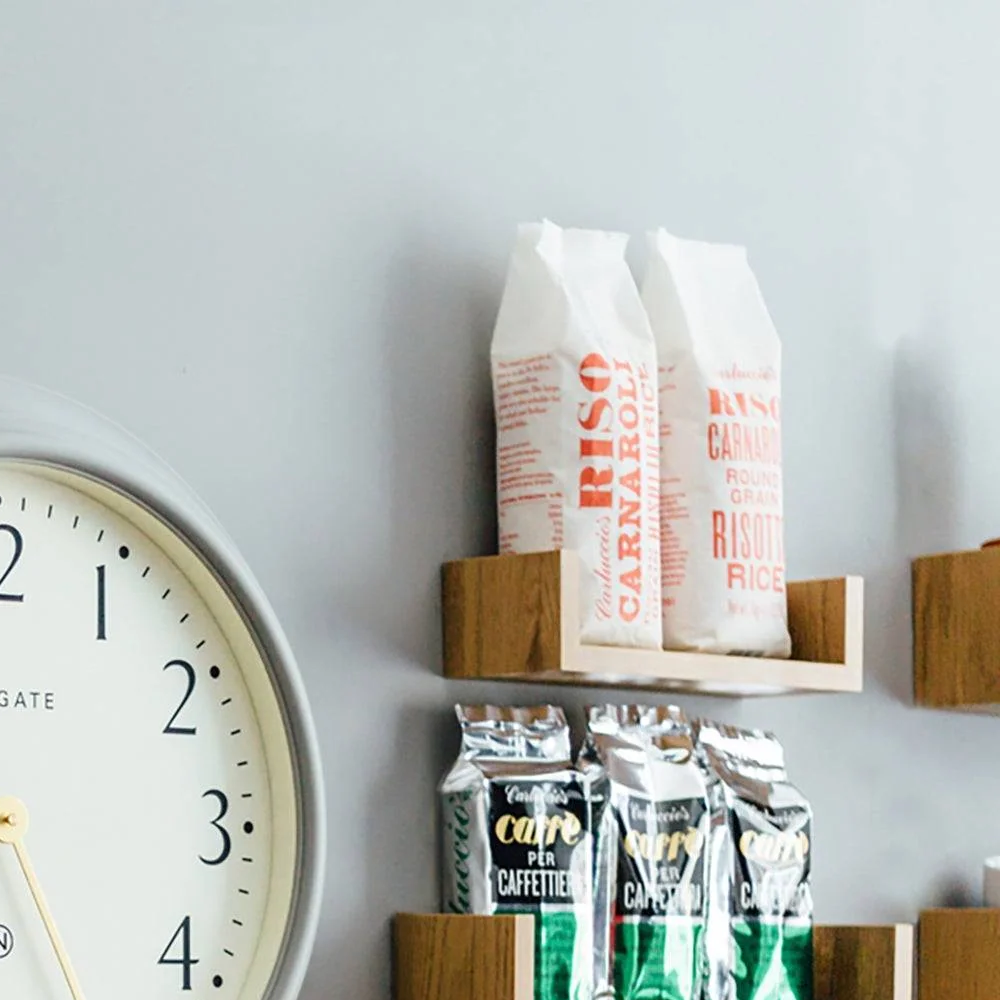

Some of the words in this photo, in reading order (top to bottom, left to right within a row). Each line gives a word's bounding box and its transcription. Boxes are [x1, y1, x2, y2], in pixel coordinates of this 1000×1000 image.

[577, 353, 613, 508] RISO
[613, 357, 642, 622] CARNAROLI
[96, 565, 107, 641] 1
[727, 563, 784, 593] RICE
[162, 659, 197, 736] 2
[199, 789, 232, 866] 3
[528, 851, 556, 867] PER
[157, 915, 200, 991] 4
